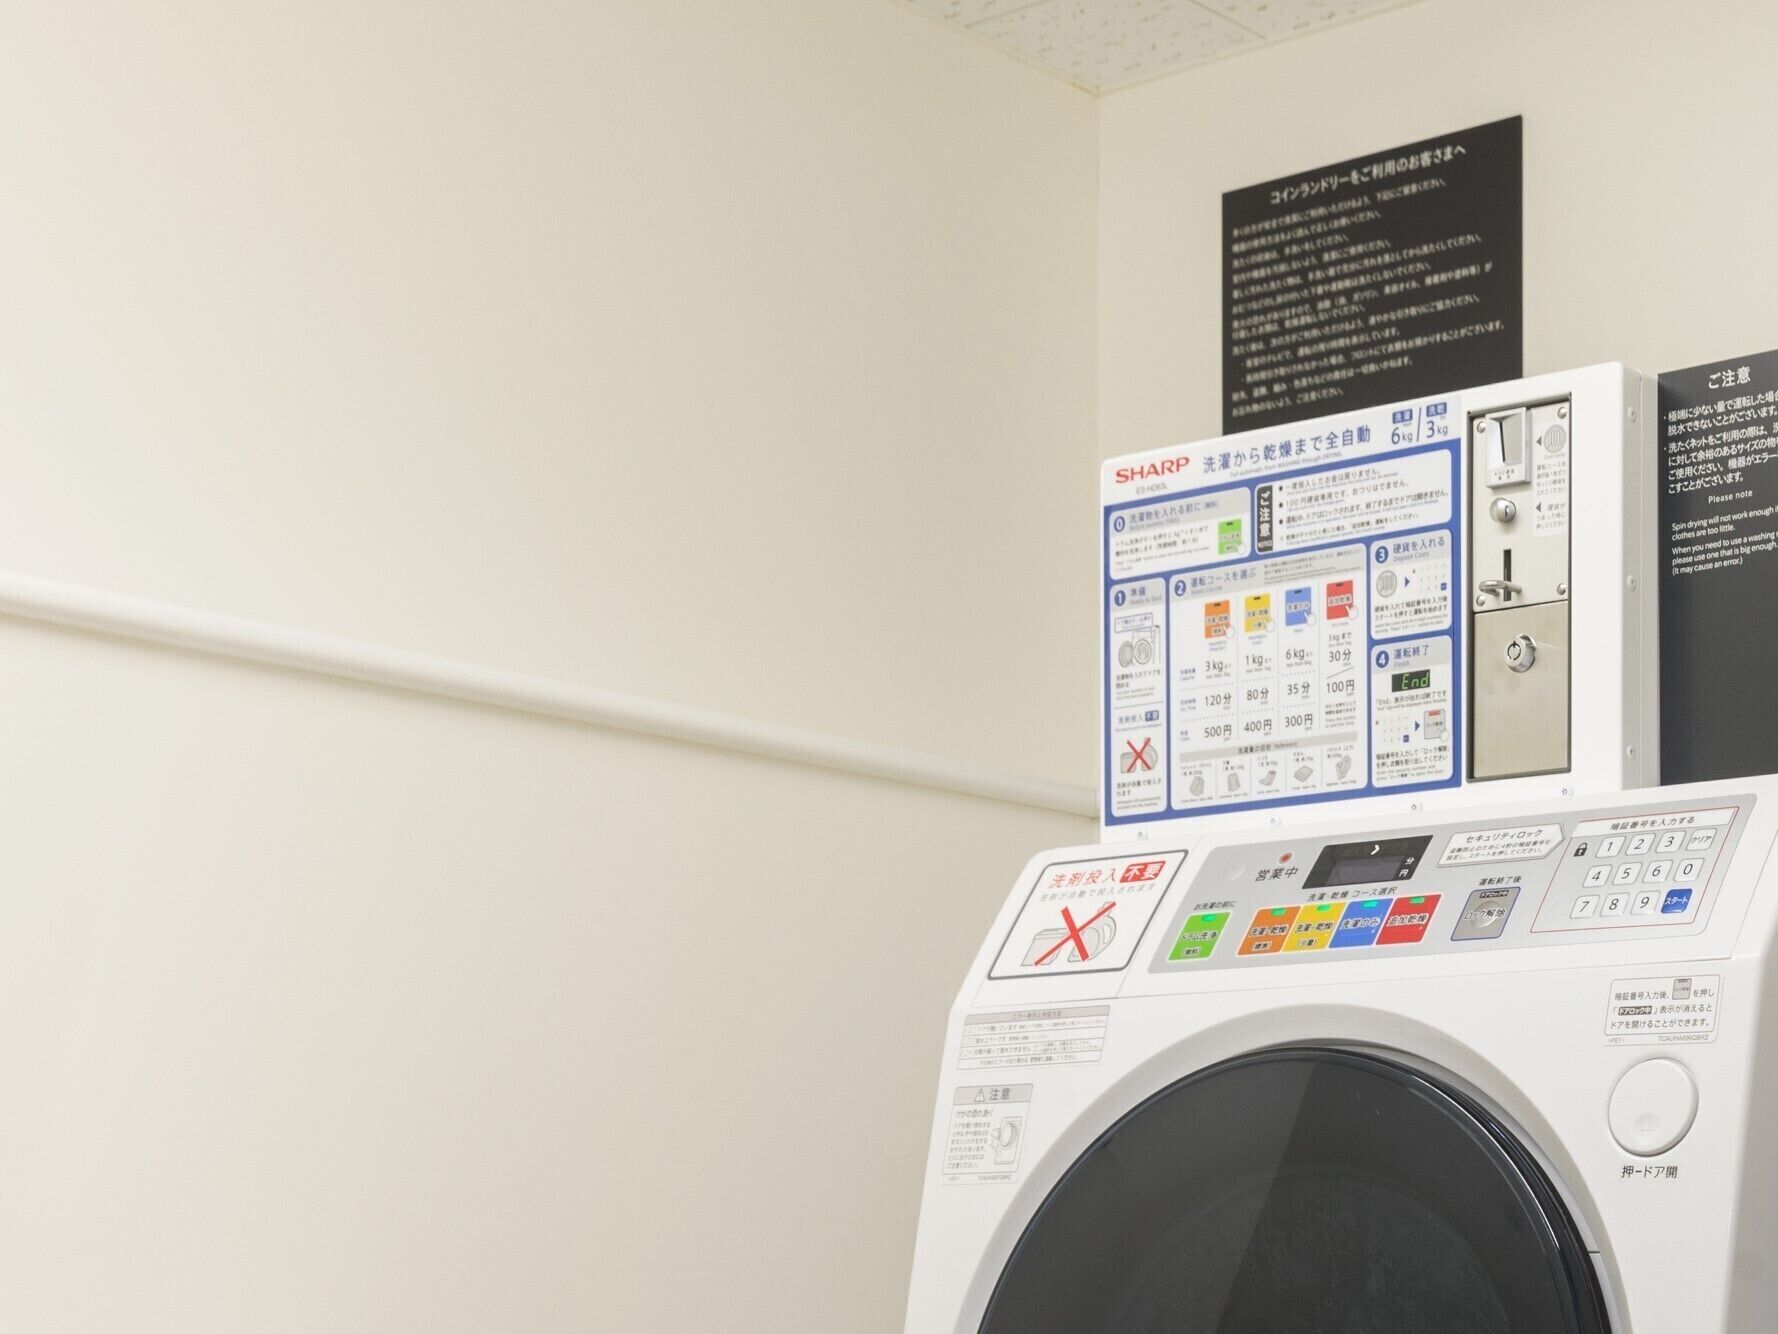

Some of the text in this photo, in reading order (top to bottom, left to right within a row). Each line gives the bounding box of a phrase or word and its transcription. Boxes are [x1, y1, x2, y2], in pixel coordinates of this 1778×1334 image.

[1270, 145, 1466, 204] コインランドリーをご利用のお客さまへ
[1708, 366, 1751, 389] ご注意
[1202, 424, 1371, 473] 洗濯から乾燥まで全自動
[1115, 456, 1190, 484] SHARP
[1668, 472, 1744, 494] こすことがございます。
[1708, 489, 1753, 504] Please note
[1610, 816, 1696, 831] 暗証番号を入力する
[1466, 828, 1543, 843] セキュリティロック
[1048, 863, 1162, 889] 洗剤投入 不要
[1255, 866, 1299, 882] 営業中
